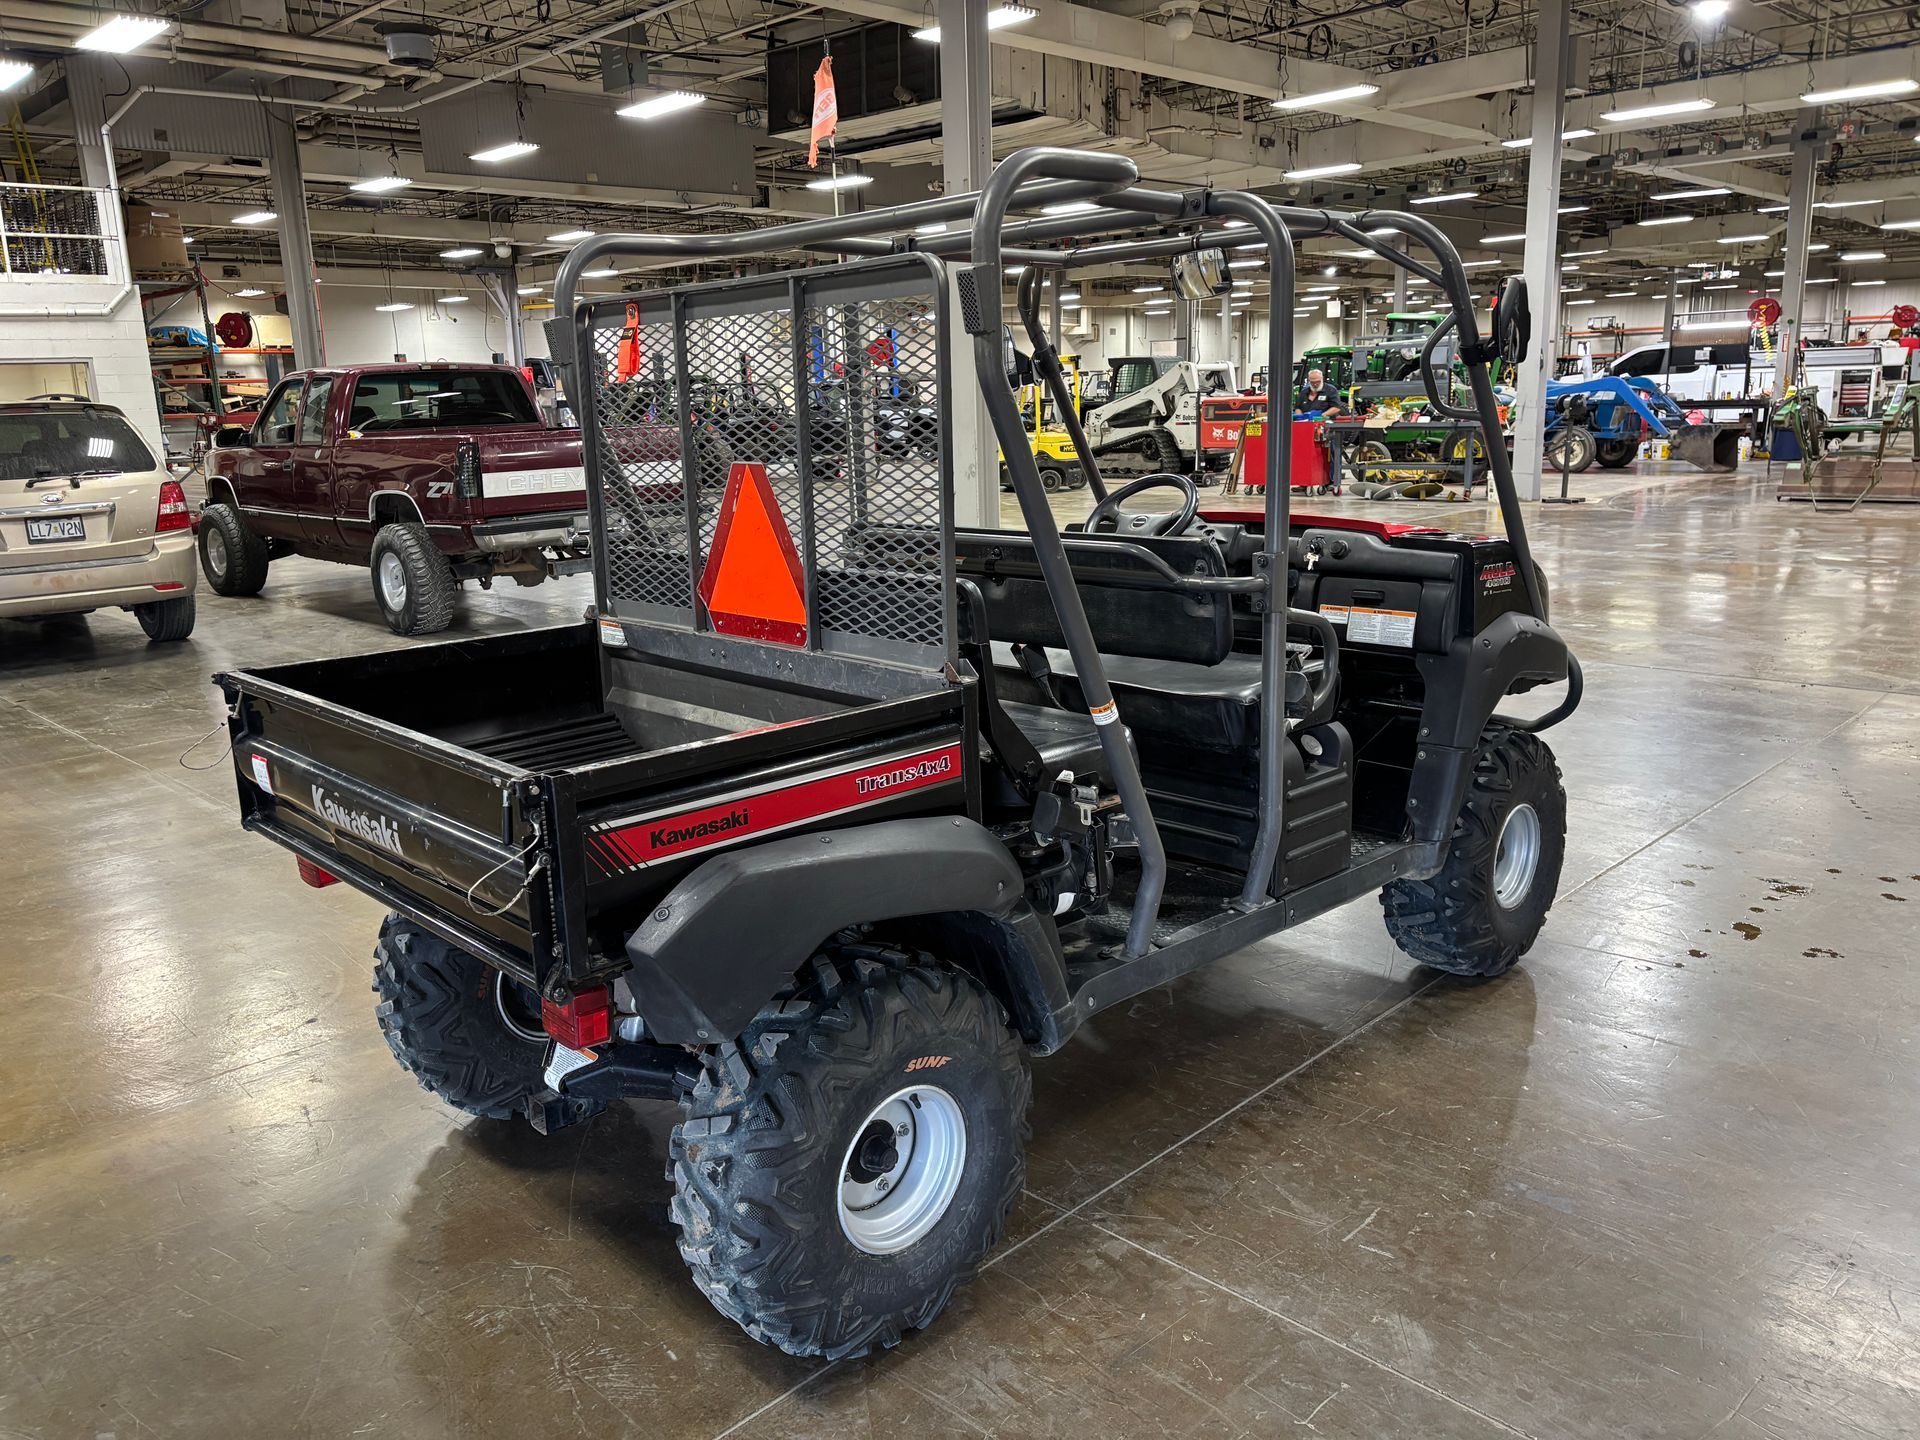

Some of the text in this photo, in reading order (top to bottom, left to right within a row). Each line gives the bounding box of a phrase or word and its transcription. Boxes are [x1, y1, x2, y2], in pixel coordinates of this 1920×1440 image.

[1703, 141, 1714, 150] 93
[1748, 137, 1759, 146] 95
[426, 481, 454, 498] Z71
[29, 521, 82, 538] LL7 V2N
[855, 755, 950, 794] Trans4x4
[311, 784, 403, 856] Kawasaki
[650, 808, 748, 849] Kawasaki
[903, 1055, 953, 1073] SUNF
